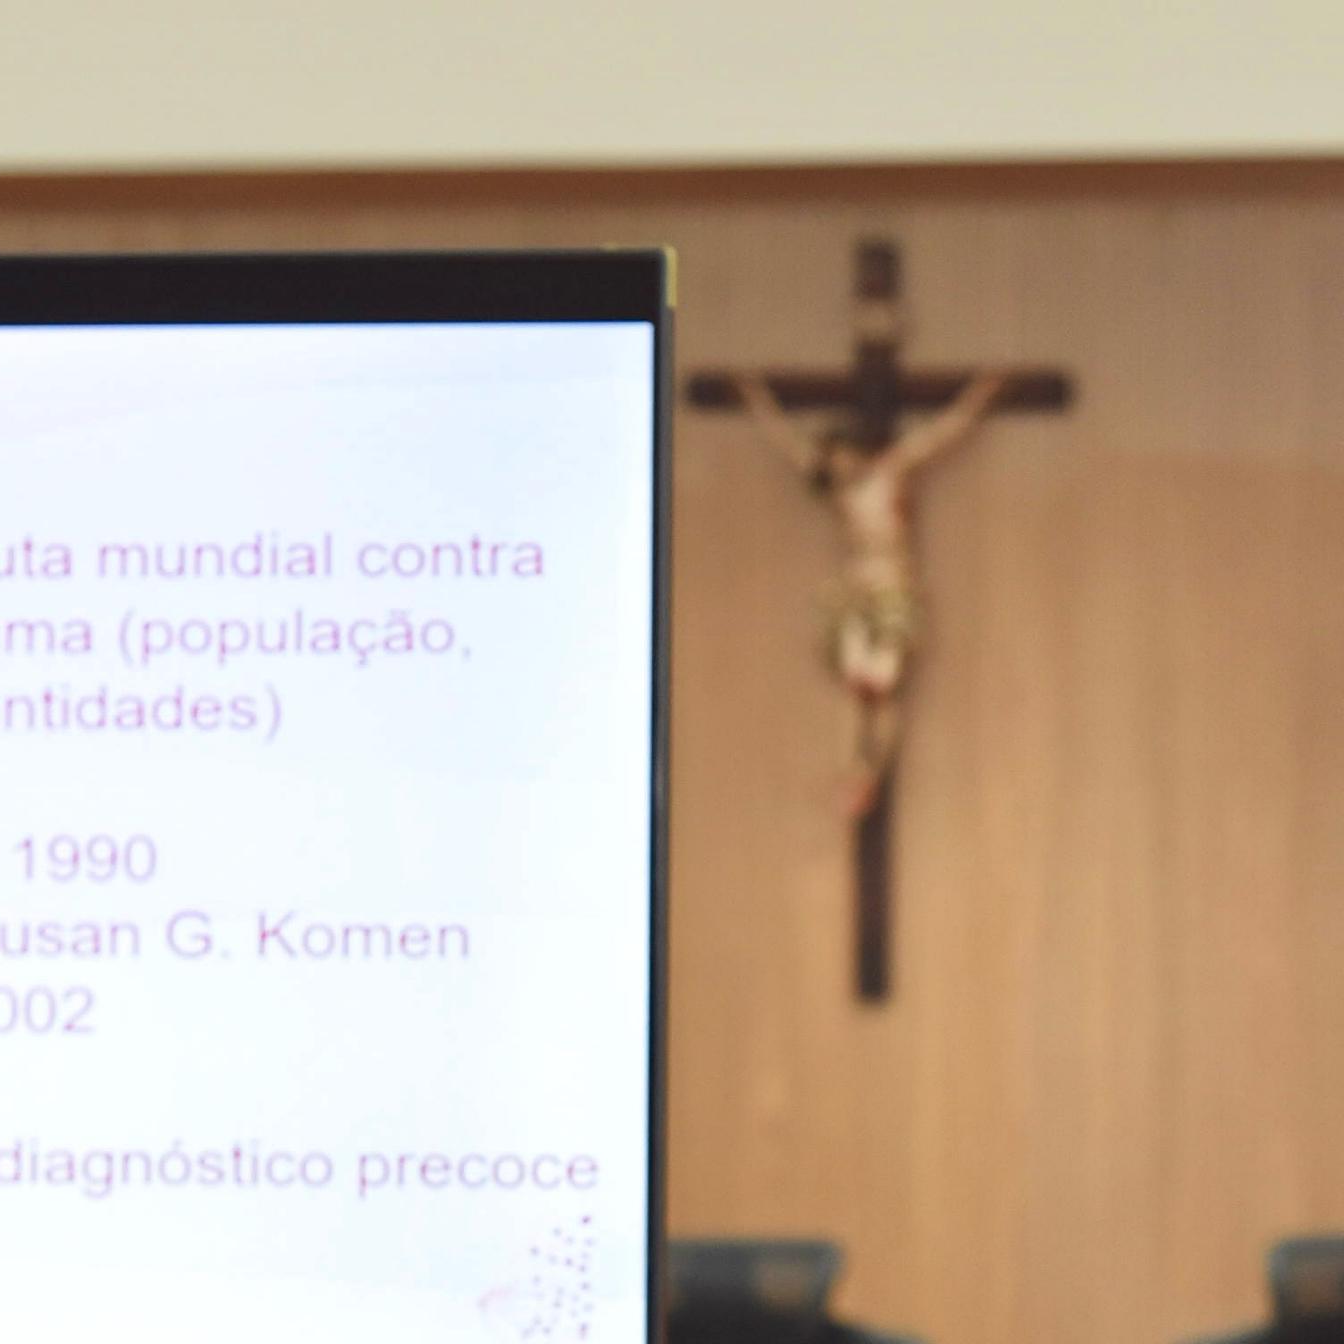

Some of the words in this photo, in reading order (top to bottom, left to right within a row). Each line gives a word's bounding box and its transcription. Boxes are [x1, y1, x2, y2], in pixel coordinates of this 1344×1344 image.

[96, 531, 335, 581] mundial
[355, 533, 547, 581] contra
[116, 608, 473, 668] (população,
[16, 833, 160, 884] 1990
[164, 908, 234, 960] G.
[255, 909, 472, 961] Komen
[355, 1151, 601, 1200] precoce
